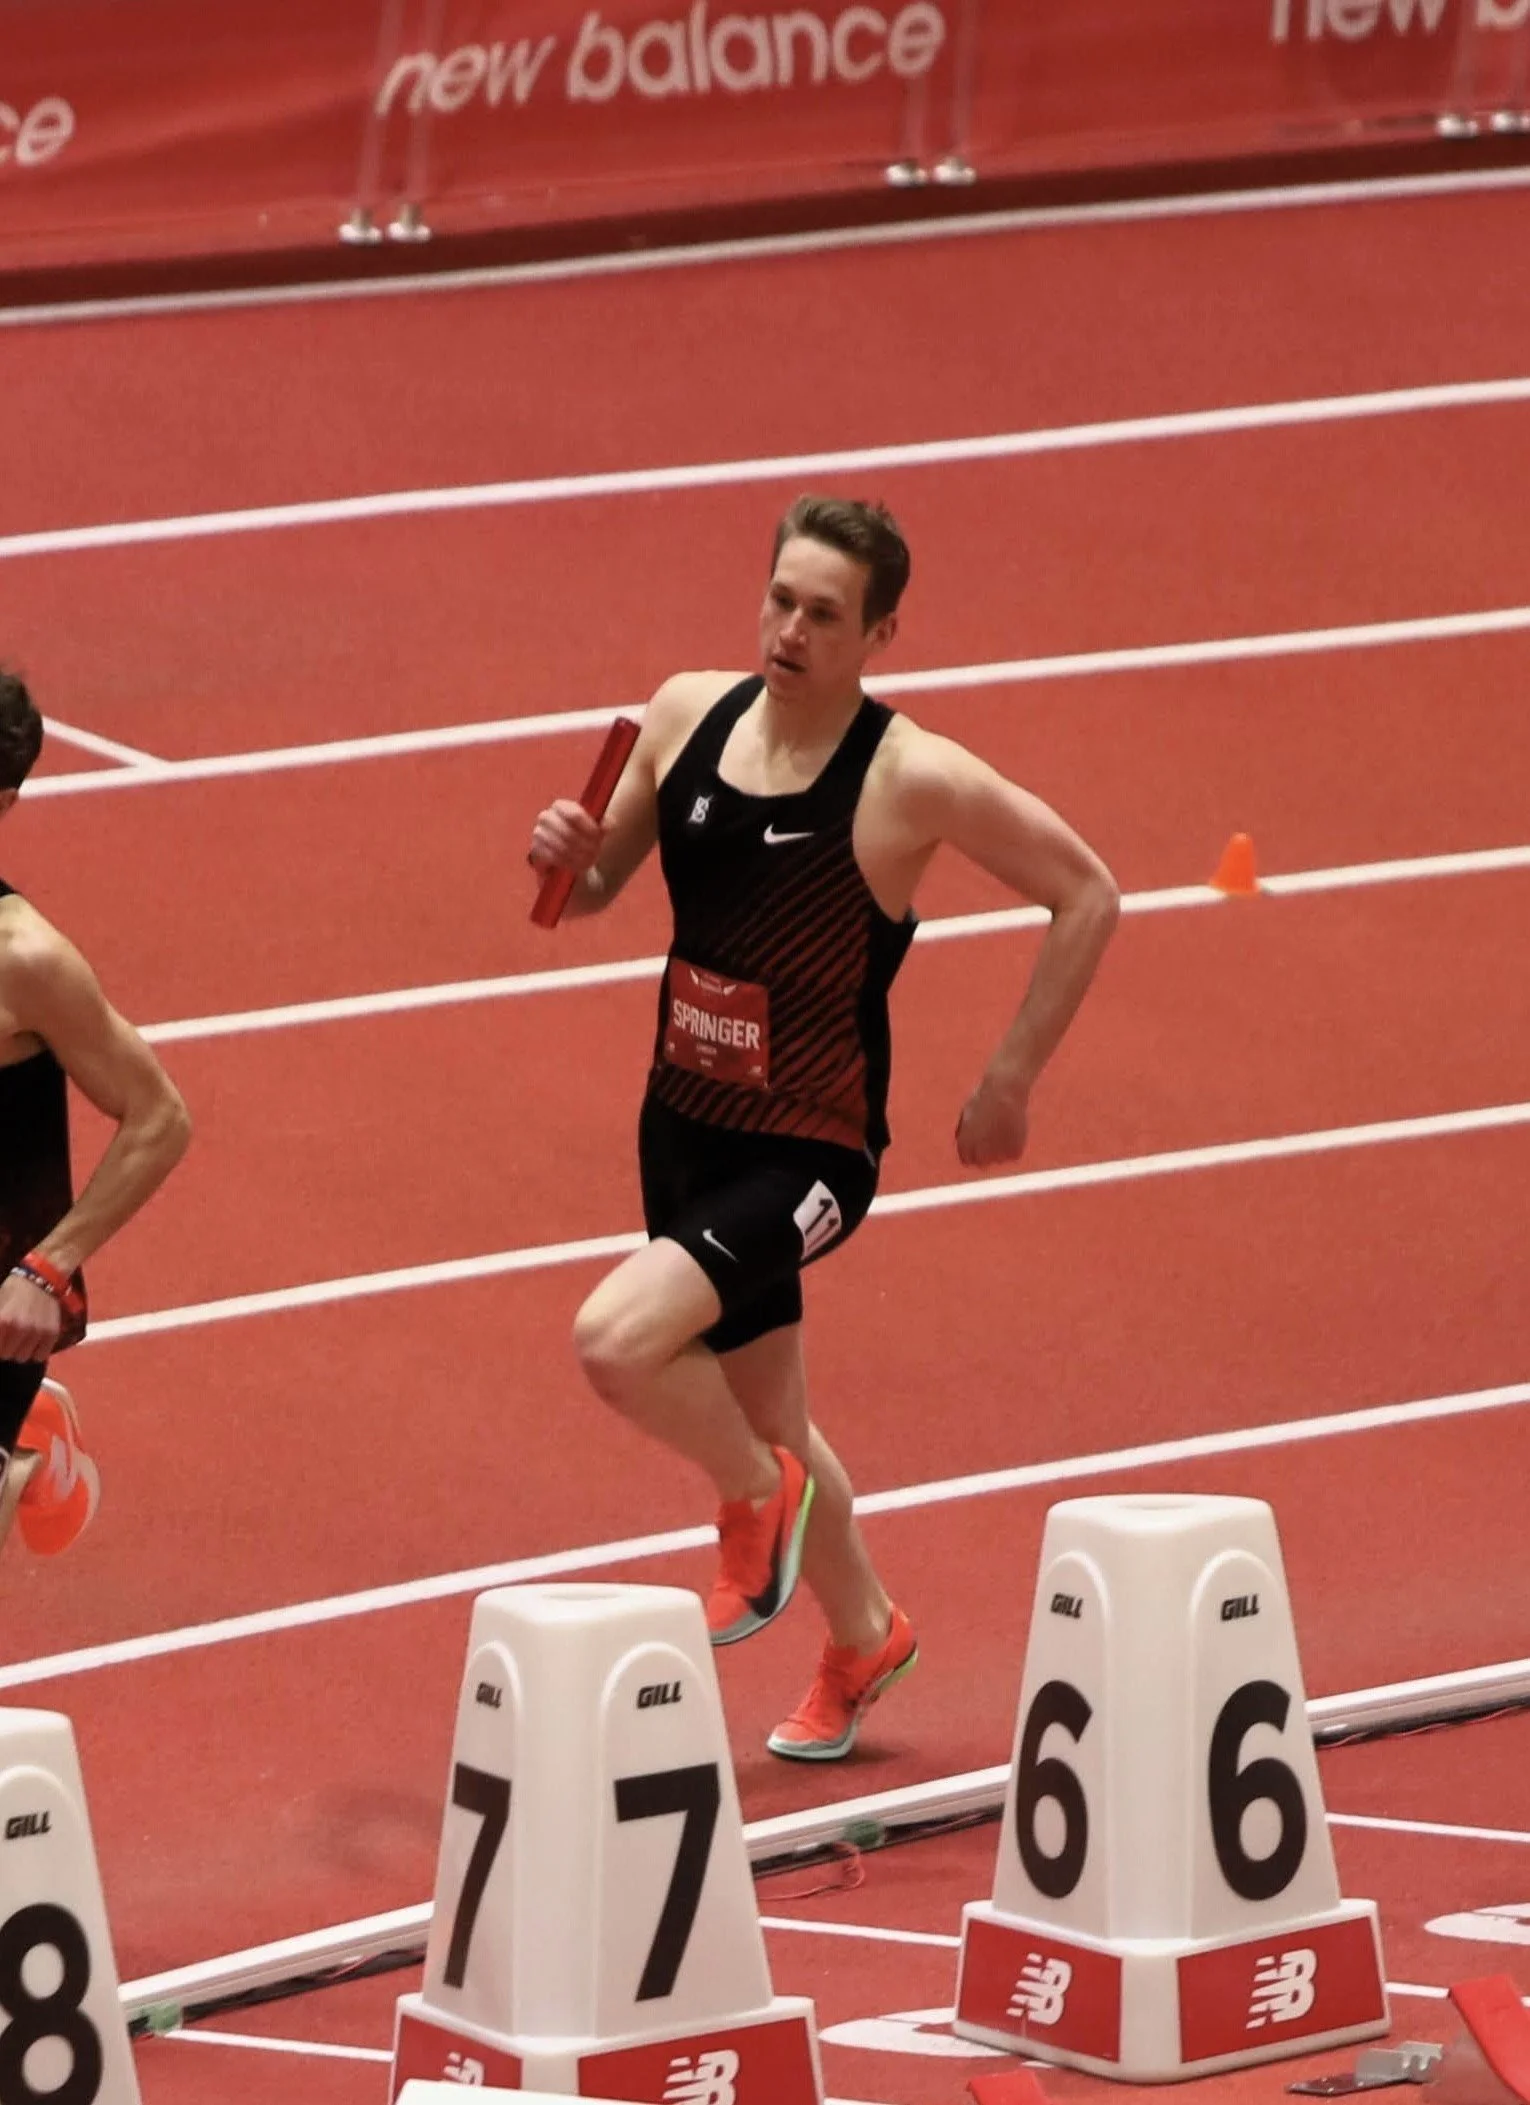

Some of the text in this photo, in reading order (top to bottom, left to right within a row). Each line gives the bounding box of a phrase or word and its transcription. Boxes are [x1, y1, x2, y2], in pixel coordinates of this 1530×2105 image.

[376, 0, 945, 115] new balance
[673, 998, 760, 1050] SPRINGER
[1050, 1593, 1083, 1619] GILL
[1220, 1594, 1260, 1621] GILL
[475, 1682, 502, 1709] GILL
[636, 1681, 682, 1709] GILL
[4, 1811, 51, 1839] GILL
[1016, 1680, 1093, 1900] 6
[1208, 1680, 1308, 1901] 6
[443, 1762, 512, 1989] 7
[614, 1762, 721, 2002] 7
[0, 1902, 103, 2105] 8
